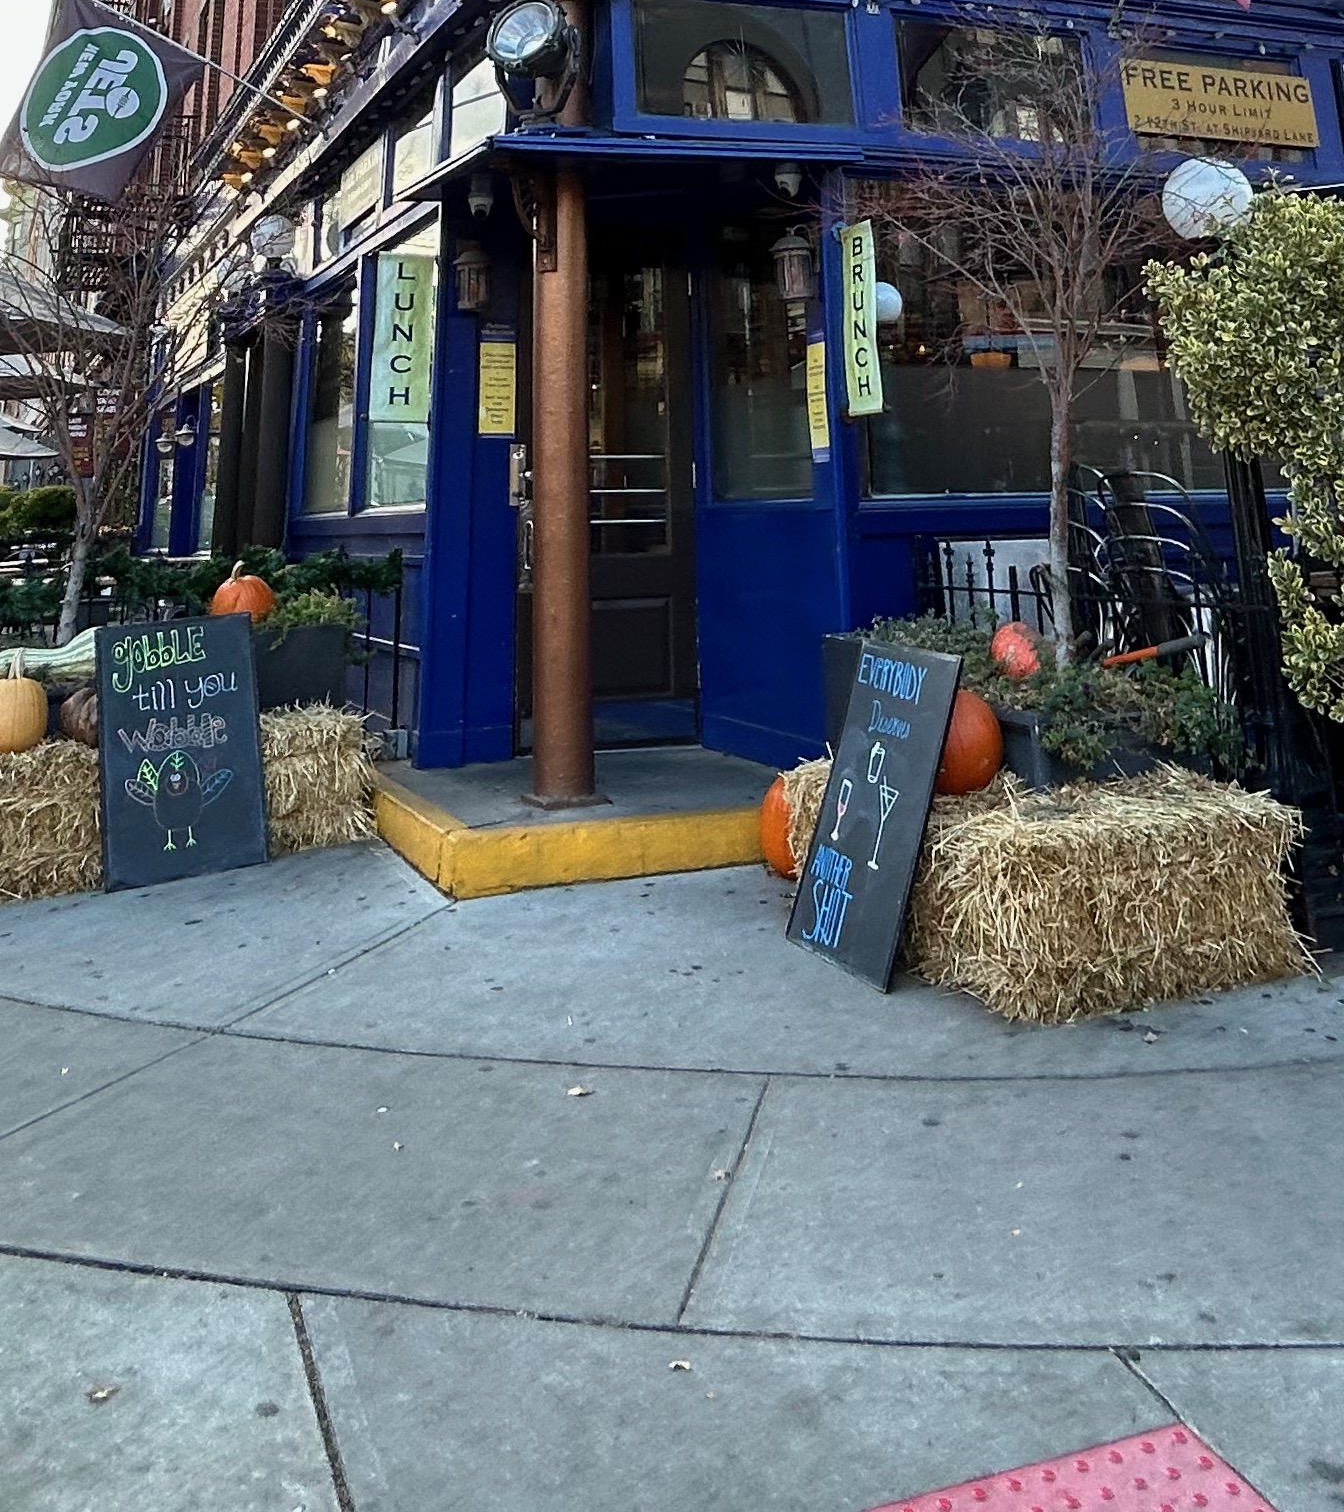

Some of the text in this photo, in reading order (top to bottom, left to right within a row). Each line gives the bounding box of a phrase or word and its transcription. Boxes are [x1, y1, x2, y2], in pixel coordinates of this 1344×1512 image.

[1125, 65, 1311, 103] FREE PARKING
[1171, 98, 1180, 111] 3
[388, 262, 416, 406] LUNCH
[852, 235, 871, 398] BRUNCH
[132, 672, 238, 711] till you
[858, 653, 928, 705] EVERYBODY
[810, 844, 853, 891] ANOTHER
[802, 879, 853, 948] SHOT
